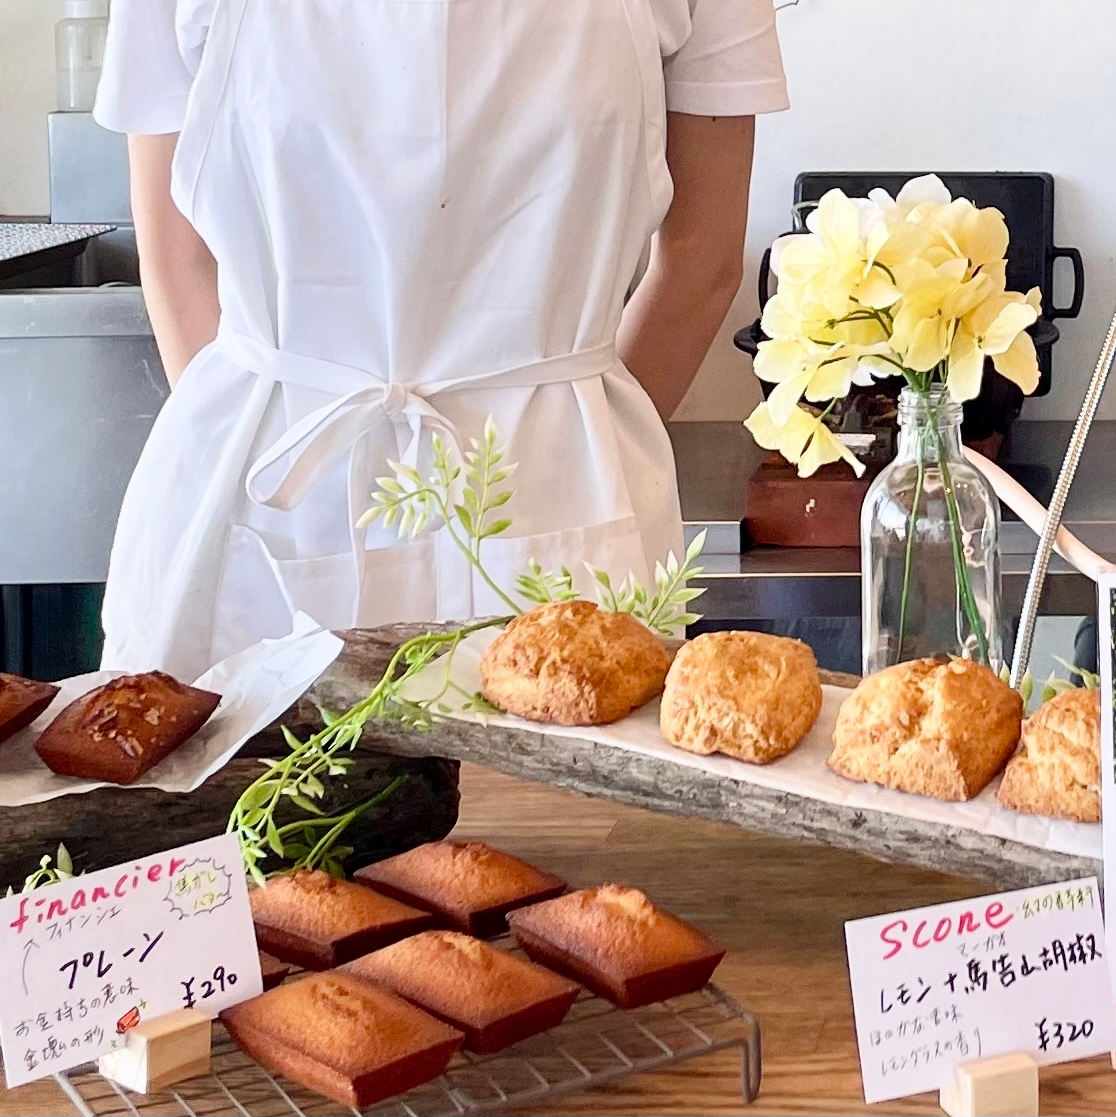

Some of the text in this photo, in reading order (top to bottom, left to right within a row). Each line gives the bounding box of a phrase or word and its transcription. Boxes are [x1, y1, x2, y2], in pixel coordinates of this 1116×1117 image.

[10, 856, 186, 934] financier
[59, 930, 165, 990] プレーン
[180, 965, 238, 1010] ¥290
[1035, 1017, 1095, 1053] ¥320
